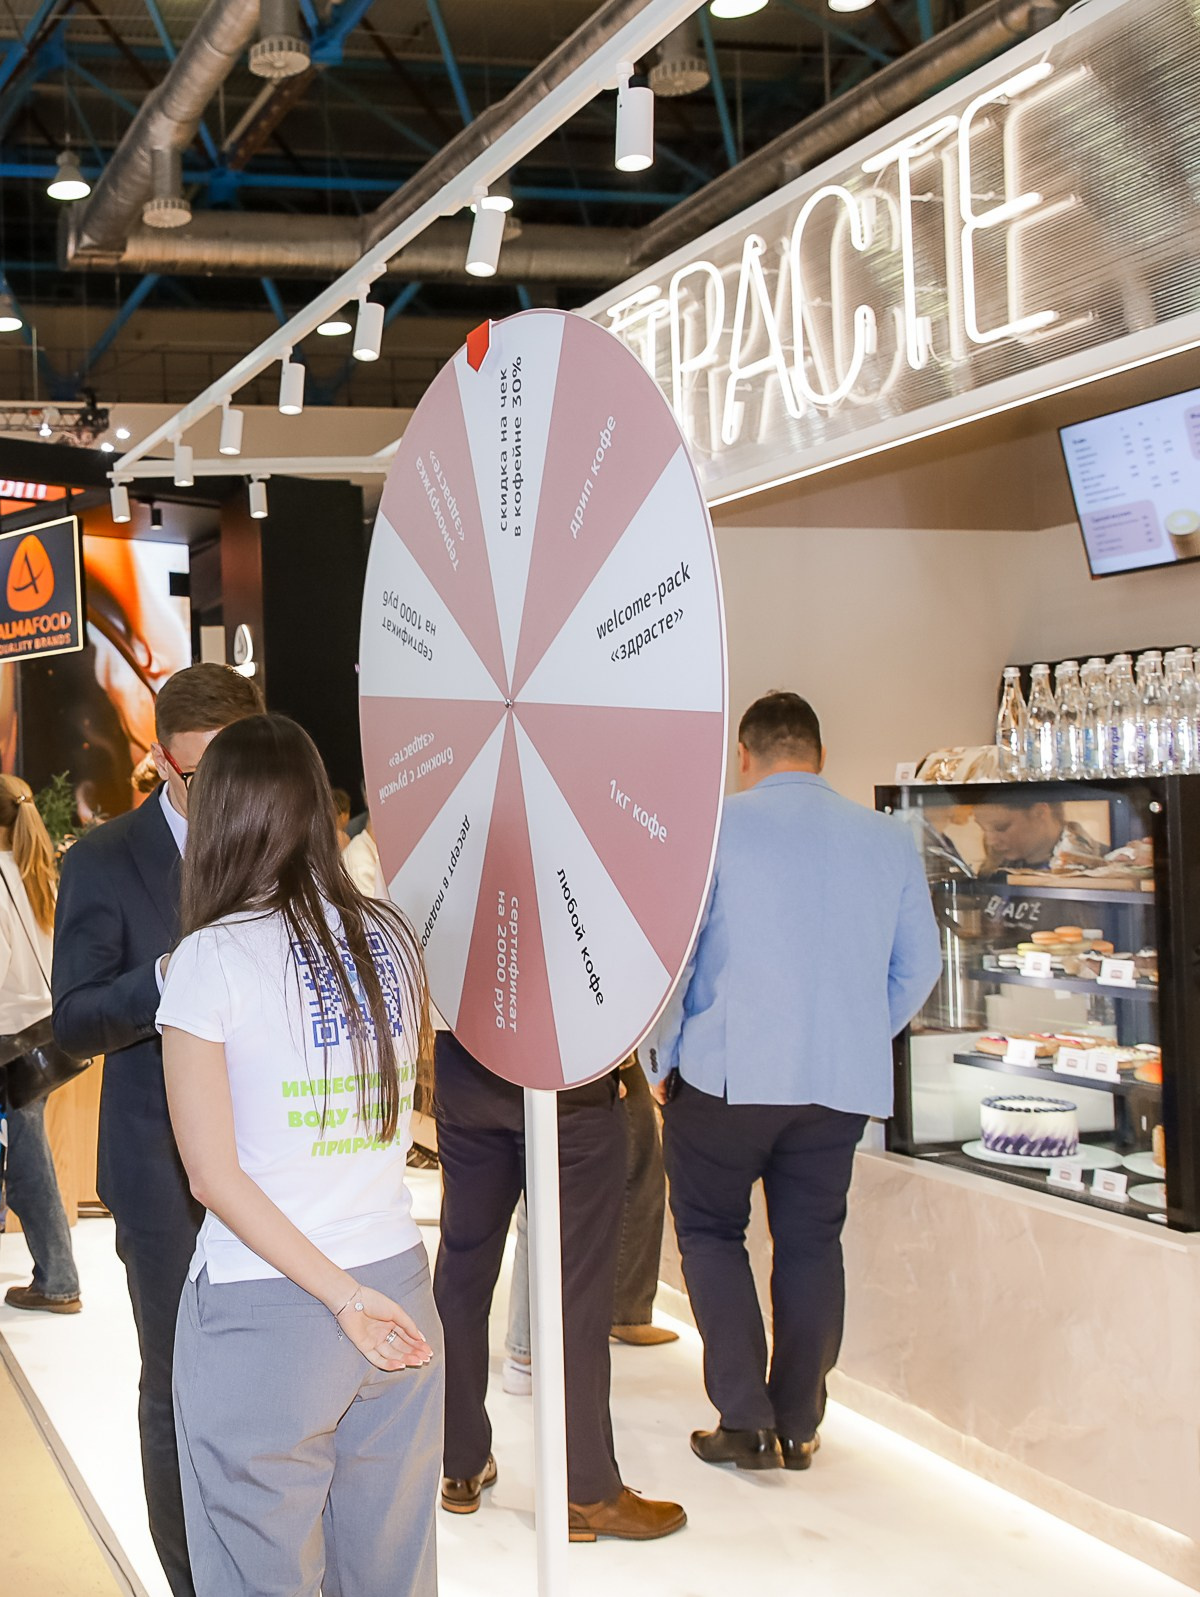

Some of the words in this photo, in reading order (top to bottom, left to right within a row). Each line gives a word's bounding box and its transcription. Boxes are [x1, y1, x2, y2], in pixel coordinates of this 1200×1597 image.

[500, 367, 508, 409] чек
[511, 356, 522, 409] 30%
[500, 415, 508, 443] на
[512, 416, 524, 517] кофейне
[569, 478, 594, 539] дрип
[590, 415, 617, 476] кофе
[429, 449, 465, 541] «здрасте»
[500, 450, 509, 532] скидка
[415, 456, 459, 572] термокружка
[514, 524, 522, 537] в
[382, 590, 399, 609] руб
[400, 602, 422, 630] 1000
[596, 561, 691, 640] welcome-pack
[33, 632, 71, 649] BRANDS
[381, 615, 433, 662] сертификат
[425, 619, 437, 636] на
[610, 608, 684, 662] «здрасте»
[388, 731, 435, 768] «здрасте»
[416, 746, 454, 780] блокнот
[378, 767, 409, 805] ручкой
[409, 771, 415, 782] с
[609, 778, 631, 810] 1кг
[632, 803, 668, 843] кофе
[447, 814, 471, 877] десерт
[442, 876, 450, 890] в
[497, 890, 506, 916] на
[419, 888, 445, 952] подаро
[556, 868, 586, 942] любой
[580, 946, 604, 1006] кофе
[496, 922, 507, 983] 2000
[507, 895, 519, 1033] сертификат
[494, 987, 506, 1030] руб
[288, 1108, 349, 1129] ВОДУ
